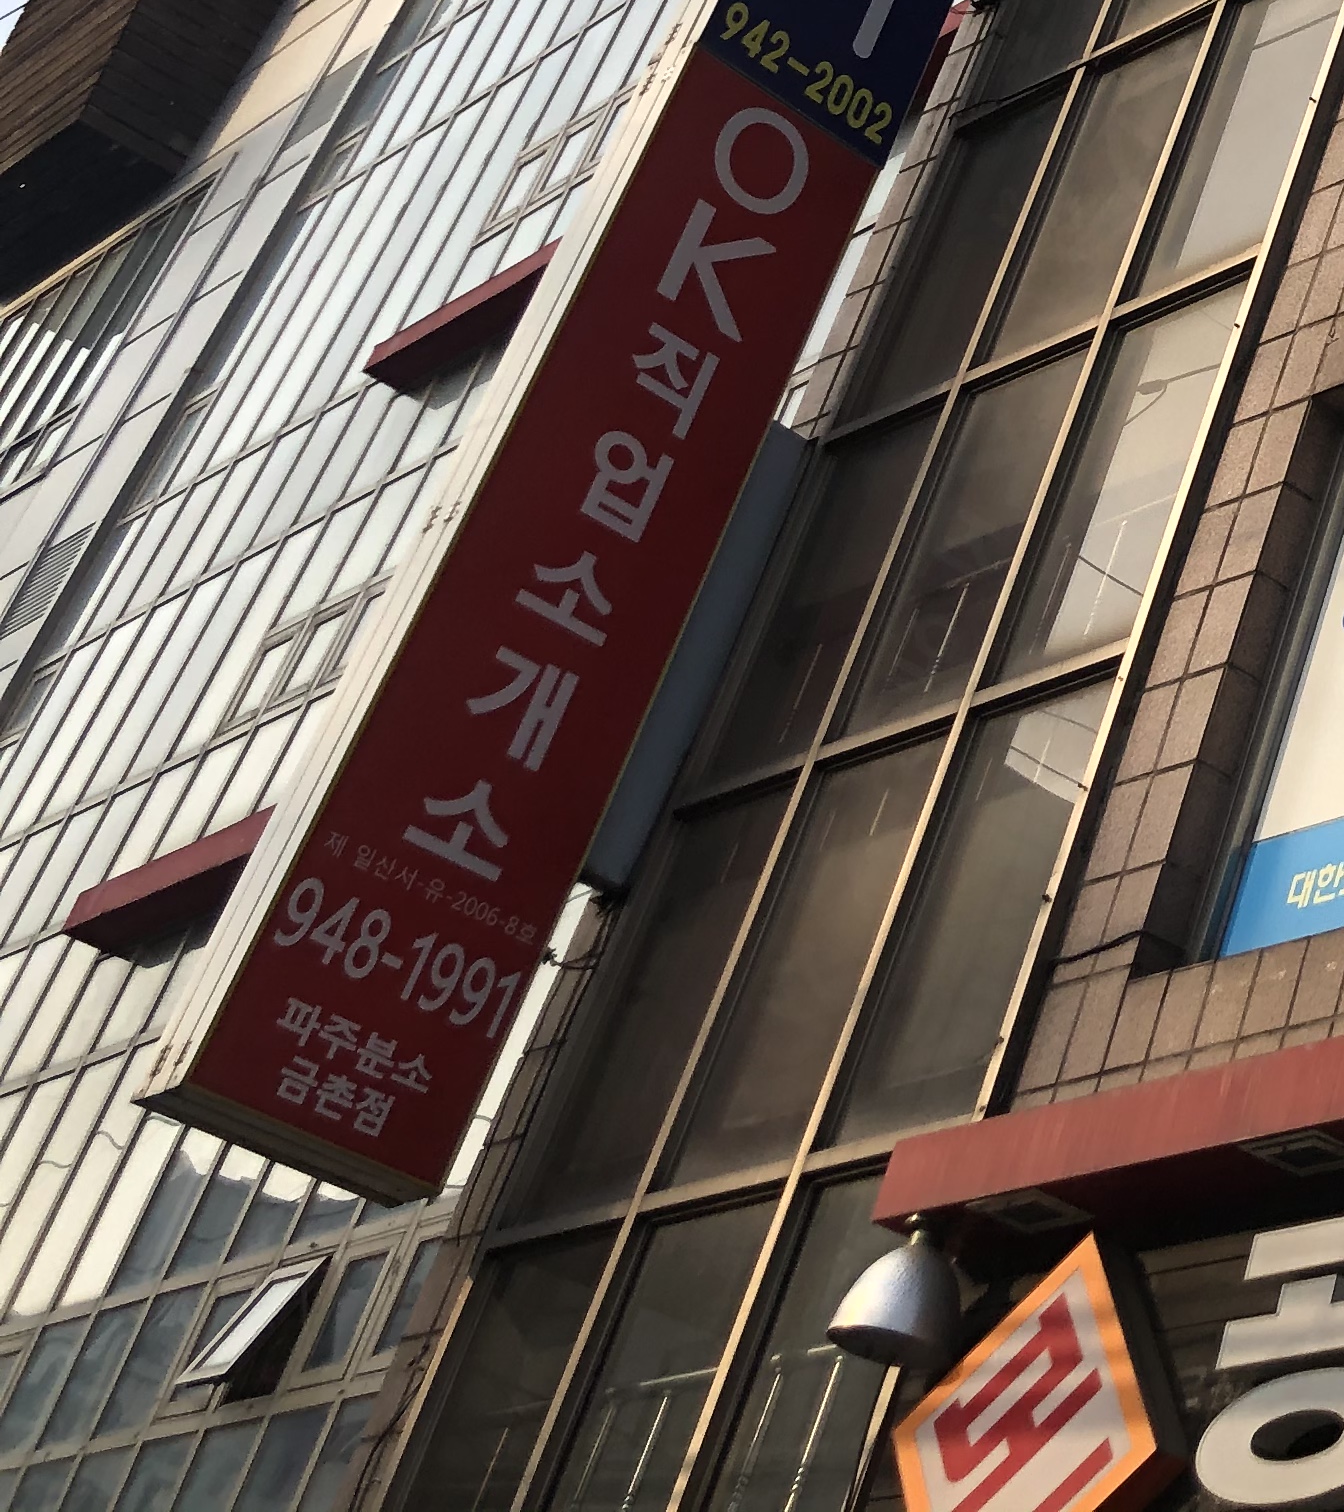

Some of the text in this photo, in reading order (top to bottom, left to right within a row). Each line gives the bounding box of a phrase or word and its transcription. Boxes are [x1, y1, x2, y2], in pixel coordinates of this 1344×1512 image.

[722, 1, 894, 146] 942-2002
[273, 876, 523, 1040] 948-1991
[276, 996, 433, 1094] 파주분소
[276, 1054, 396, 1138] 금촌점
